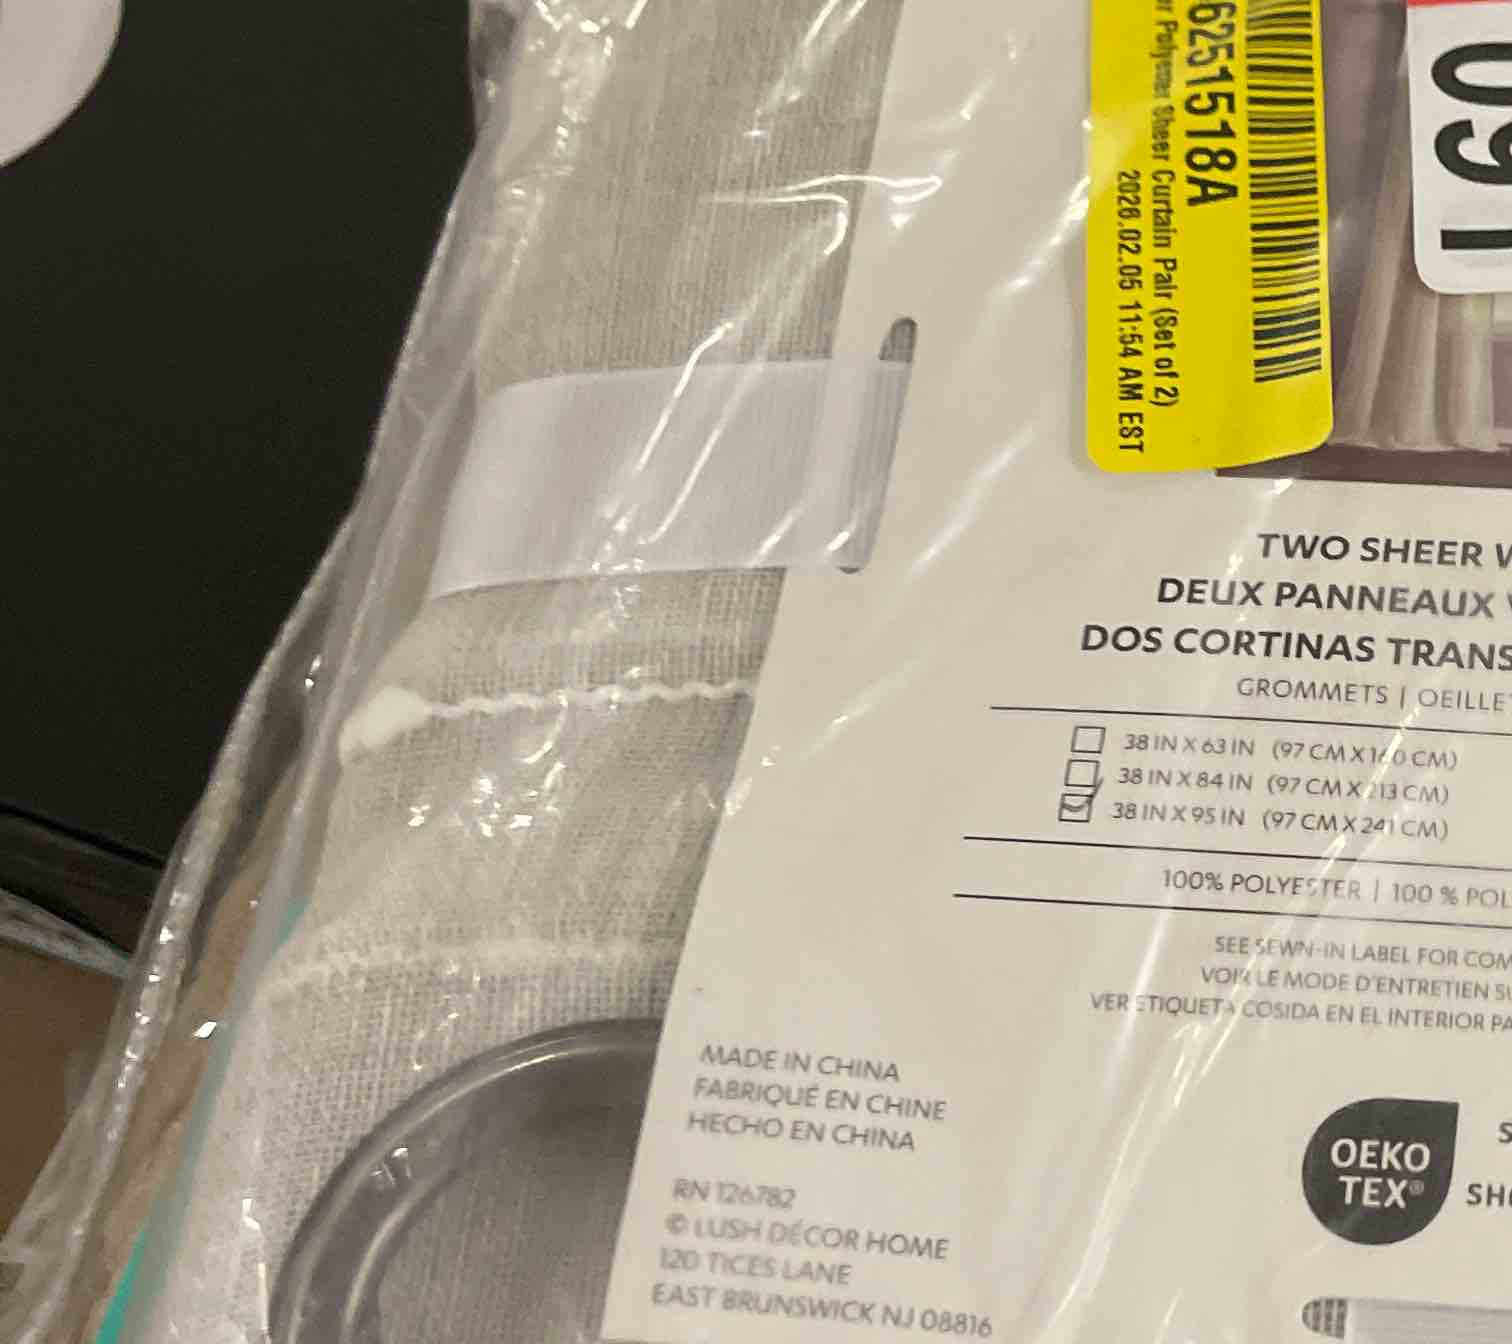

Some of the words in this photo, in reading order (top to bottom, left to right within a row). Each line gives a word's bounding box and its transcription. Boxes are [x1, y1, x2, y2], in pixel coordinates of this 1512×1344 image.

[1152, 170, 1178, 249] Curtain
[1153, 257, 1178, 301] Pair
[1118, 300, 1144, 359] 11:54
[1149, 308, 1179, 351] (Set
[1118, 367, 1144, 402] AM
[1154, 356, 1180, 378] of
[1149, 383, 1180, 407] 2)
[1118, 411, 1145, 454] EST
[1257, 533, 1350, 560] TWO
[1360, 537, 1483, 567] SHEER
[1157, 577, 1264, 607] DEUX
[1274, 581, 1495, 619] PANNEAUX
[1080, 624, 1163, 654] DOS
[1174, 627, 1375, 663] CORTINAS
[1237, 678, 1388, 705] GROMMETS
[1123, 733, 1149, 752] 38
[1152, 734, 1180, 754] IN
[1201, 736, 1228, 755] 63
[1231, 737, 1255, 756] IN
[1272, 739, 1305, 762] (97
[1309, 743, 1345, 761] CM
[1411, 750, 1458, 771] CM)
[1118, 767, 1143, 786] 38
[1147, 769, 1172, 788] IN
[1197, 770, 1225, 790] 84
[1228, 772, 1253, 792] IN
[1267, 774, 1302, 796] (97
[1305, 778, 1342, 799] CM
[1403, 784, 1449, 806] CM)
[1112, 802, 1137, 821] 38
[1141, 803, 1168, 823] IN
[1191, 805, 1217, 825] 95
[1220, 808, 1245, 827] IN
[1263, 809, 1297, 831] (97
[1300, 813, 1338, 832] CM
[1361, 816, 1395, 834] 241
[1401, 819, 1449, 841] CM)
[1162, 868, 1224, 892] 100%
[1230, 872, 1362, 902] POLYESTER
[1392, 882, 1434, 905] 100
[1214, 935, 1249, 955] SEE
[1255, 938, 1346, 961] SEWN-IN
[1351, 944, 1411, 967] LABEL
[1417, 947, 1458, 968] FOR
[1256, 969, 1280, 988] LE
[1283, 971, 1350, 992] MODE
[1356, 975, 1490, 1000] D'ENTRETIEN
[1089, 992, 1129, 1010] VER
[1242, 999, 1320, 1022] COSIDA
[1326, 1005, 1355, 1025] EN
[1360, 1007, 1384, 1026] EL
[1388, 1007, 1485, 1033] INTERIOR
[700, 1044, 777, 1072] MADE
[783, 1052, 811, 1074] IN
[817, 1055, 900, 1083] CHINA
[824, 1089, 861, 1112] EN
[866, 1093, 947, 1122] CHINE
[687, 1110, 784, 1140] HECHO
[789, 1120, 825, 1144] EN
[831, 1124, 915, 1152] CHINA
[1330, 1137, 1431, 1173] OEKO
[672, 1177, 711, 1202] RN
[694, 1216, 762, 1243] LUSH
[866, 1230, 949, 1260] HOME
[660, 1247, 698, 1272] 120
[708, 1252, 777, 1279] TICES
[782, 1258, 852, 1286] LANE
[652, 1282, 716, 1307] EAST
[722, 1288, 873, 1324] BRUNSWICK
[881, 1304, 915, 1331] NJ
[920, 1309, 993, 1338] 08816
